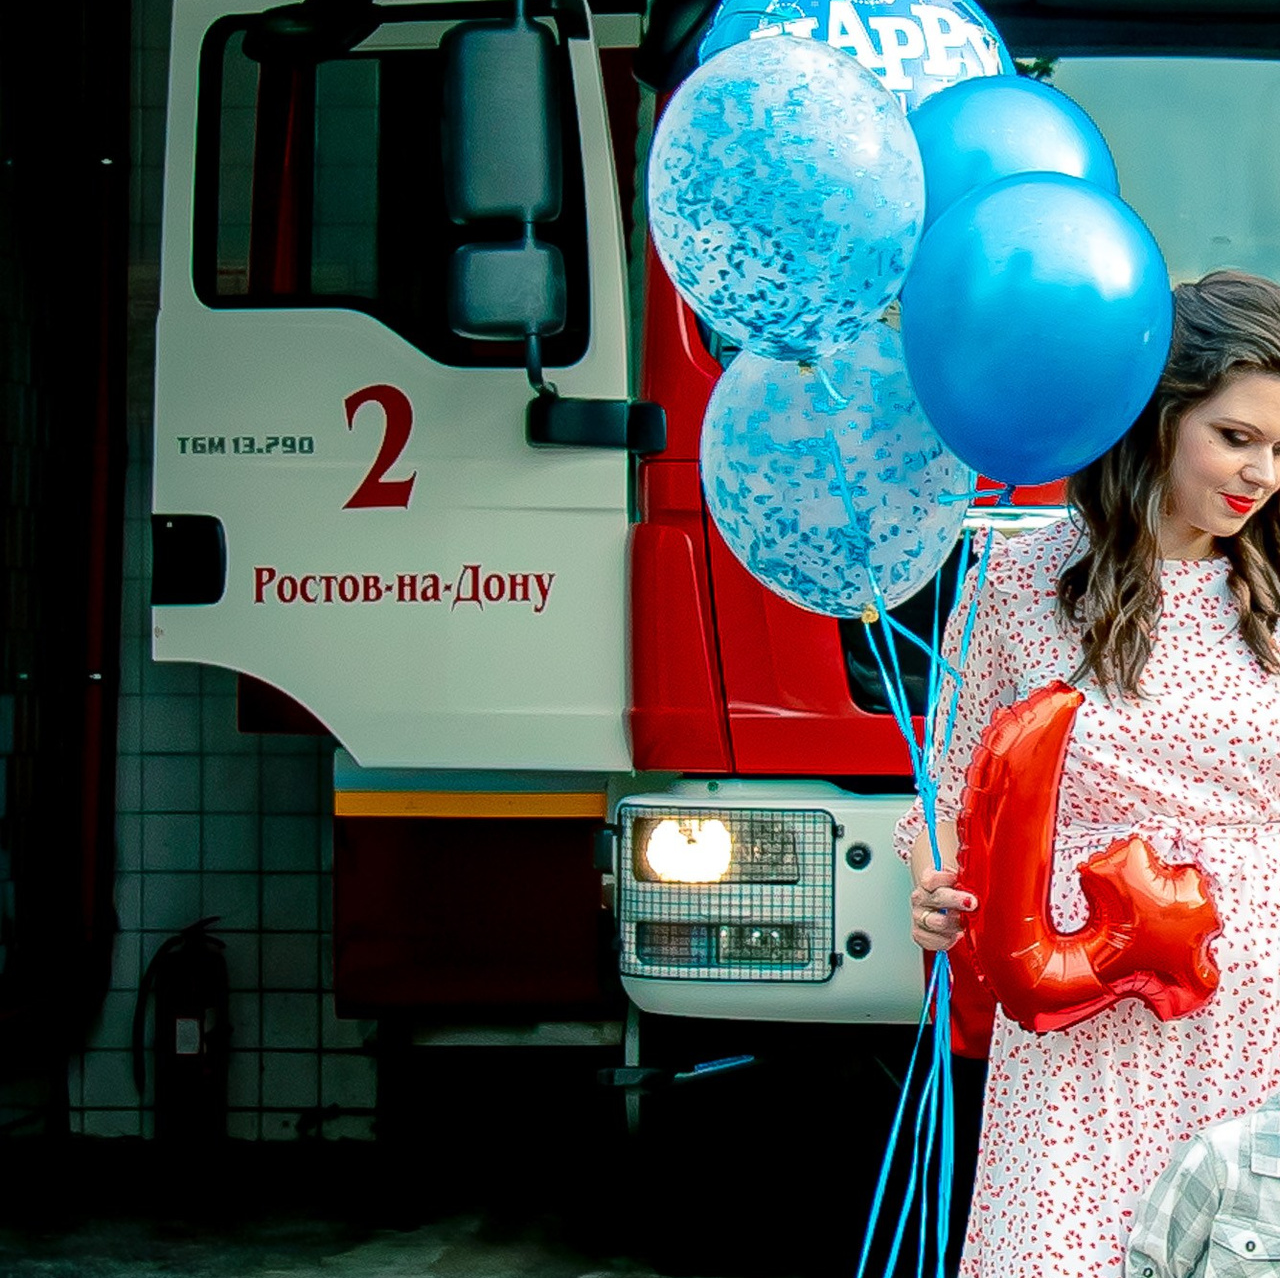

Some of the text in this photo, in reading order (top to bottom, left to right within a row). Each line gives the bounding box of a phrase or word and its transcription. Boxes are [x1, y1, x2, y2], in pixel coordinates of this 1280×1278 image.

[177, 436, 226, 454] TGM
[341, 384, 418, 511] 2
[253, 563, 556, 614] Ростов-на-Дону
